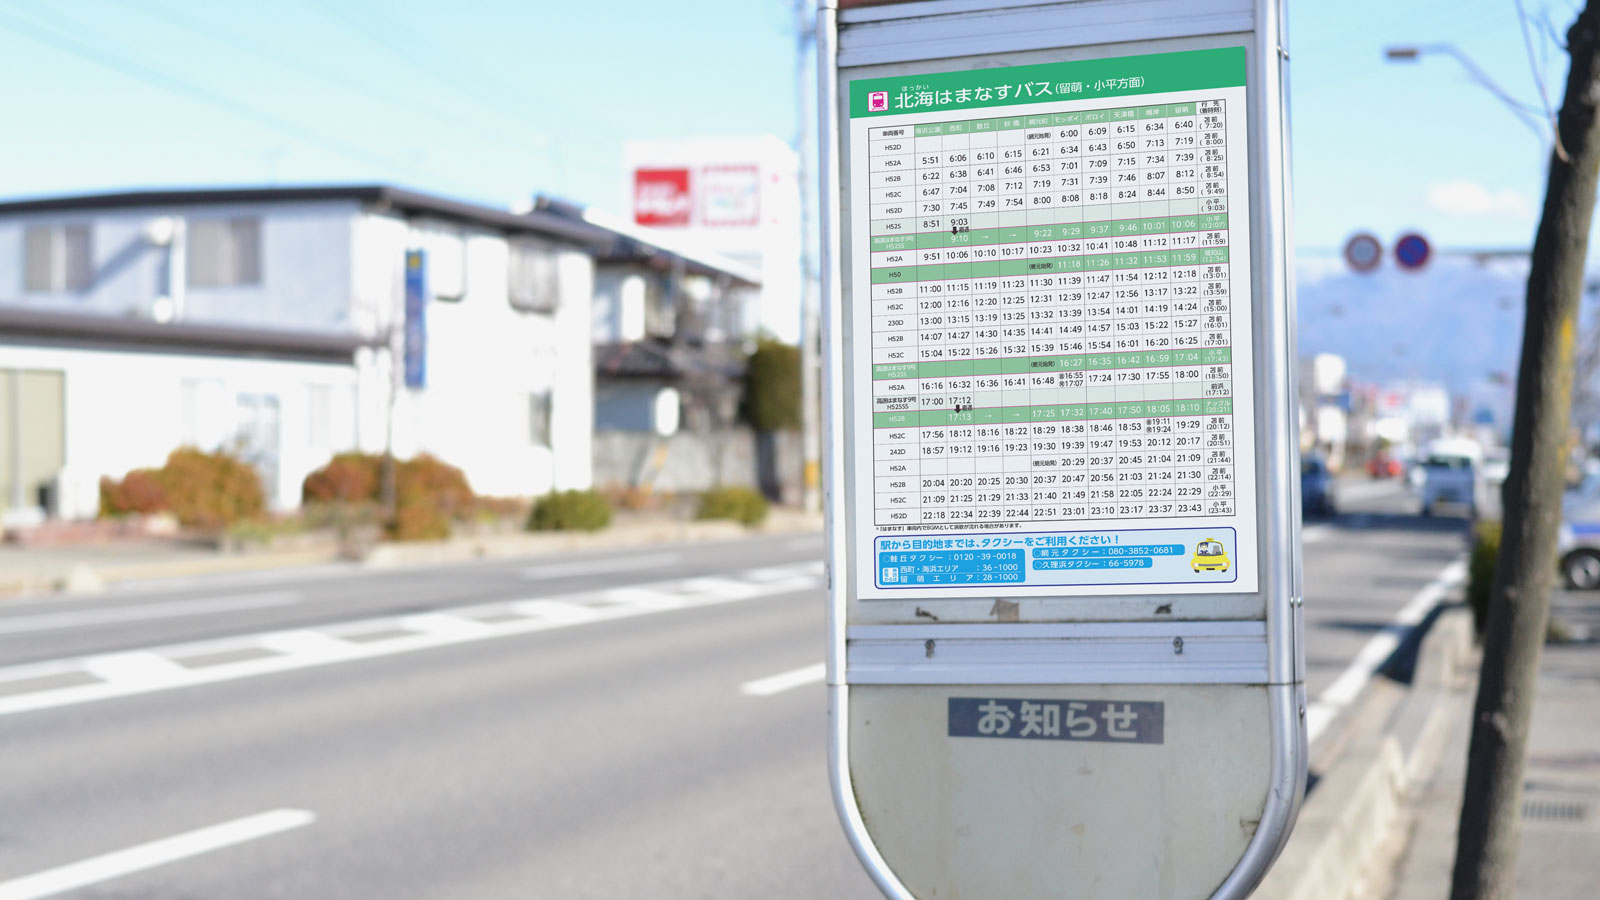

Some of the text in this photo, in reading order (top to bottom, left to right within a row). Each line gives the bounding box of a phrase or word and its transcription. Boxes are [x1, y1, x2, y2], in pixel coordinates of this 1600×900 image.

[894, 81, 1052, 108] 北海はまなすバス
[922, 156, 938, 164] 5:51
[949, 153, 966, 162] 6:06
[976, 151, 994, 160] 6:10
[1004, 149, 1022, 158] 6:15
[1032, 147, 1049, 156] 6:21
[1060, 145, 1078, 154] 6:34
[1088, 143, 1107, 152] 6:43
[1117, 141, 1135, 149] 6:50
[1146, 138, 1164, 147] 7:13
[1175, 136, 1193, 145] 7:19
[922, 187, 940, 196] 6:47
[950, 185, 967, 194] 7:04
[977, 183, 995, 192] 7:08
[1005, 181, 1022, 190] 7:12
[1033, 179, 1050, 188] 7:19
[1061, 177, 1078, 186] 7:31
[1089, 175, 1107, 184] 7:39
[1118, 173, 1136, 182] 7:46
[1146, 171, 1165, 180] 8:07
[1175, 169, 1194, 178] 8:12
[923, 220, 939, 228] 8:51
[950, 217, 968, 226] 9:03
[923, 252, 940, 260] 9:51
[946, 250, 968, 259] 10:06
[974, 248, 996, 257] 10:10
[1001, 246, 1024, 255] 10:17
[1029, 245, 1052, 253] 10:23
[1058, 243, 1080, 252] 10:32
[1086, 242, 1107, 250] 10:41
[1114, 239, 1137, 248] 10:48
[1143, 238, 1166, 246] 11:12
[1172, 236, 1195, 244] 11:17
[919, 284, 941, 293] 11:00
[946, 283, 969, 291] 11:15
[974, 281, 997, 289] 11:19
[1002, 279, 1024, 288] 11:23
[1030, 278, 1052, 286] 11:30
[1058, 276, 1081, 285] 11:39
[1086, 274, 1109, 283] 11:47
[1115, 273, 1138, 281] 11:54
[1144, 271, 1167, 280] 12:12
[1173, 269, 1196, 278] 12:18
[920, 316, 942, 325] 13:00
[947, 315, 969, 323] 13:15
[975, 313, 997, 322] 13:19
[1003, 312, 1025, 320] 13:25
[1030, 310, 1053, 319] 13:32
[1059, 308, 1082, 317] 13:39
[1087, 307, 1110, 316] 13:54
[1116, 306, 1137, 314] 14:01
[1144, 304, 1168, 312] 14:19
[920, 349, 942, 357] 15:04
[948, 347, 970, 356] 15:22
[975, 346, 998, 355] 15:26
[1003, 345, 1025, 353] 15:32
[1031, 343, 1054, 352] 15:39
[1060, 342, 1082, 350] 15:46
[1088, 340, 1110, 349] 15:54
[1117, 339, 1138, 347] 16:01
[1145, 337, 1168, 346] 16:20
[1174, 336, 1198, 345] 16:25
[921, 397, 943, 405] 17:00
[922, 446, 944, 454] 18:57
[949, 445, 972, 453] 19:12
[977, 444, 999, 452] 19:16
[1005, 443, 1027, 451] 19:23
[1033, 442, 1056, 450] 19:30
[1061, 441, 1084, 449] 19:39
[1090, 440, 1113, 448] 19:47
[1118, 438, 1142, 447] 19:53
[1147, 437, 1170, 446] 20:12
[1176, 436, 1200, 445] 20:17
[922, 479, 944, 487] 20:04
[949, 478, 972, 486] 20:20
[977, 477, 1000, 485] 20:25
[1005, 476, 1028, 484] 20:30
[1033, 475, 1056, 483] 20:37
[1061, 474, 1085, 482] 20:47
[1090, 473, 1114, 482] 20:56
[1119, 472, 1142, 481] 21:03
[1148, 471, 1171, 480] 21:24
[1177, 470, 1201, 479] 21:30
[923, 511, 945, 519] 22:18
[950, 510, 973, 518] 22:34
[978, 509, 1001, 517] 22:39
[1006, 509, 1028, 517] 22:44
[1034, 508, 1056, 516] 22:51
[1062, 507, 1084, 515] 23:01
[1091, 506, 1114, 514] 23:10
[1119, 505, 1143, 514] 23:17
[1148, 504, 1172, 513] 23:37
[1178, 503, 1201, 512] 23:43
[977, 700, 1138, 740] お知らせ
